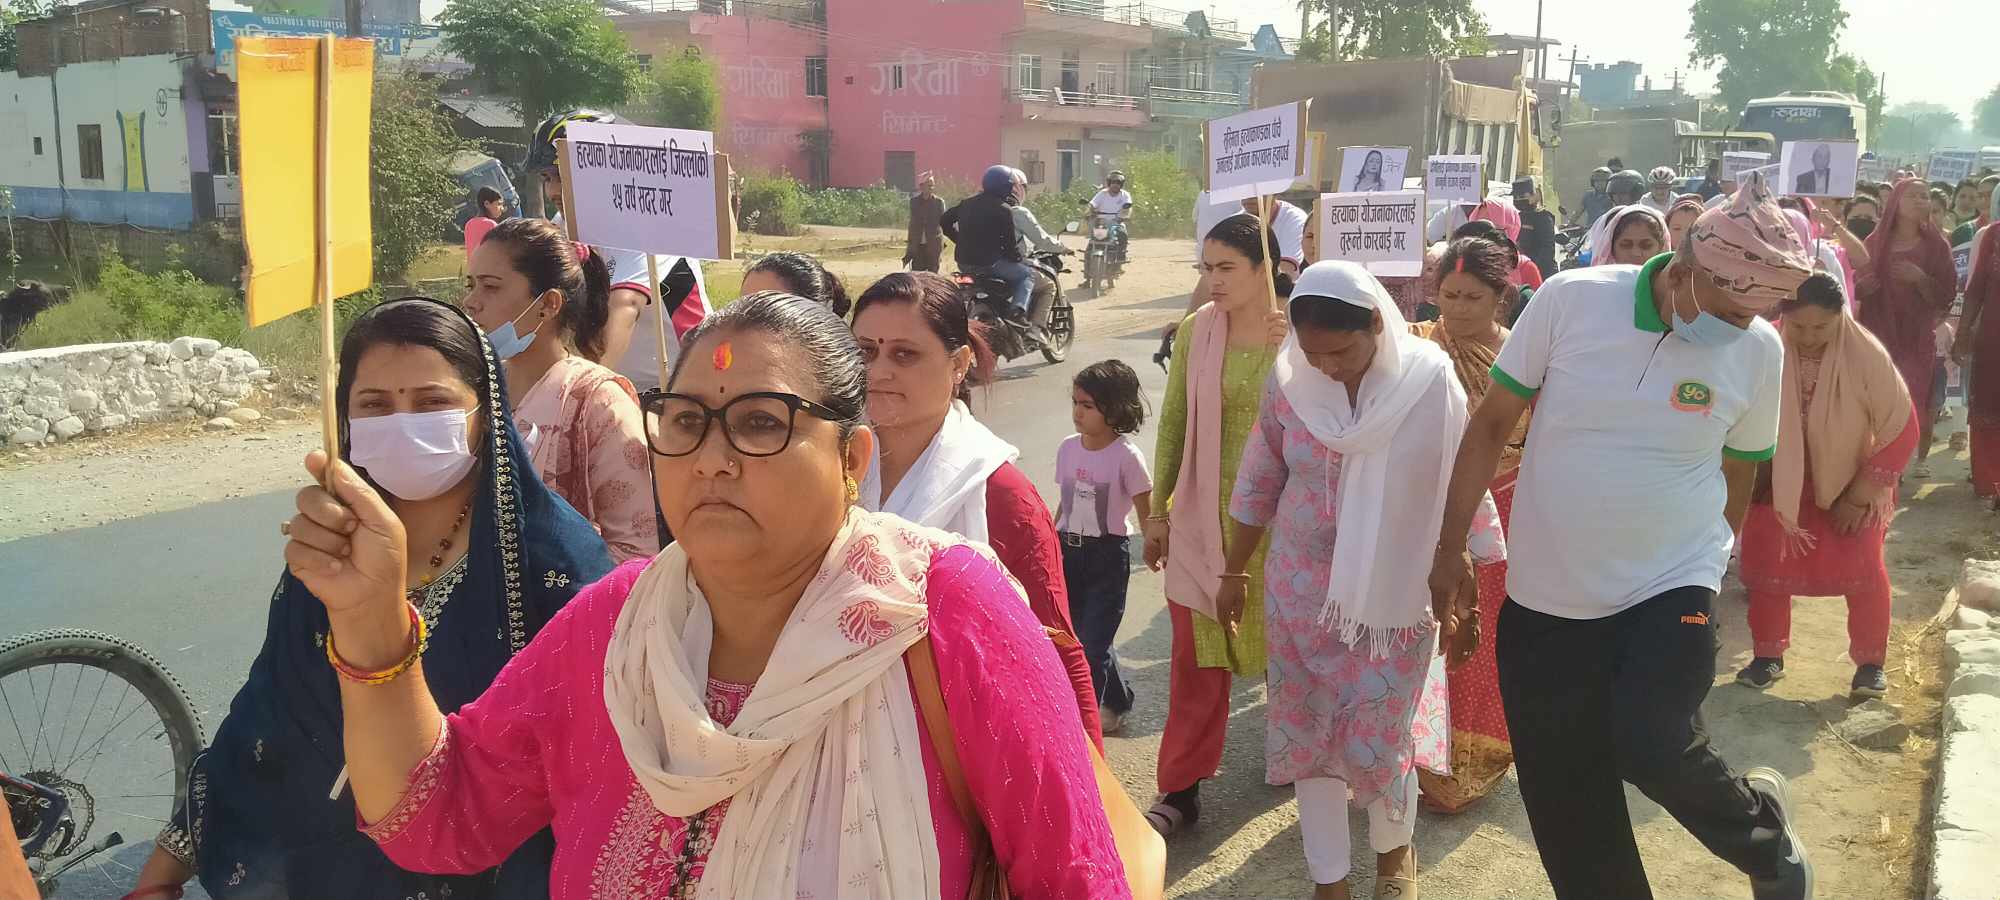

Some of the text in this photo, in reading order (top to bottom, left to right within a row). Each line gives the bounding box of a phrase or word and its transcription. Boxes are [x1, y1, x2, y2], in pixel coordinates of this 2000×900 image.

[870, 48, 961, 96] गरिमा
[608, 134, 667, 179] योजनाकारलाई
[670, 137, 709, 179] जिल्लाको
[624, 177, 637, 211] वर्ष
[638, 185, 657, 215] सदर
[659, 188, 673, 216] गर
[1361, 198, 1416, 227] योजनाकारलाई
[1394, 231, 1406, 251] गर
